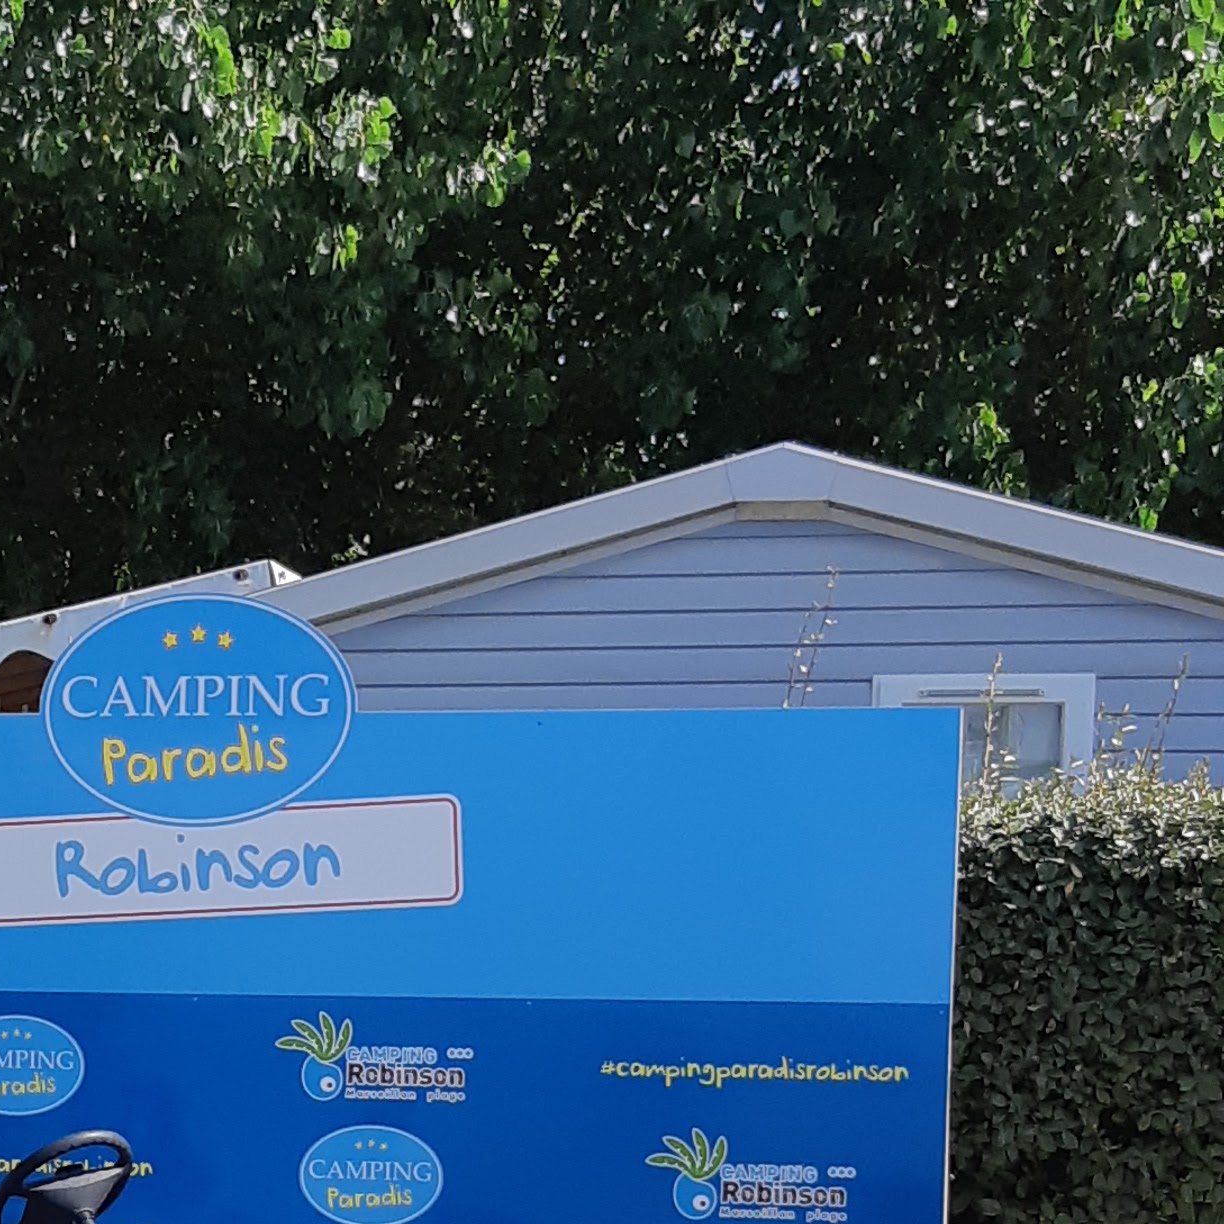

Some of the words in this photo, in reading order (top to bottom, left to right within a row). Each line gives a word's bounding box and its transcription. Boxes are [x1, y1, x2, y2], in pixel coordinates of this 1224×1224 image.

[61, 673, 330, 719] CAMPING
[102, 724, 288, 786] Paradis
[56, 833, 341, 898] Robinson
[346, 1047, 437, 1064] CAMPING
[347, 1063, 465, 1087] Robinson
[600, 1056, 909, 1088] #campingparadisrobinson
[309, 1159, 432, 1182] CAMPING
[720, 1164, 818, 1183] CAMPING
[328, 1183, 412, 1209] Paradis
[722, 1181, 847, 1206] Robinson
